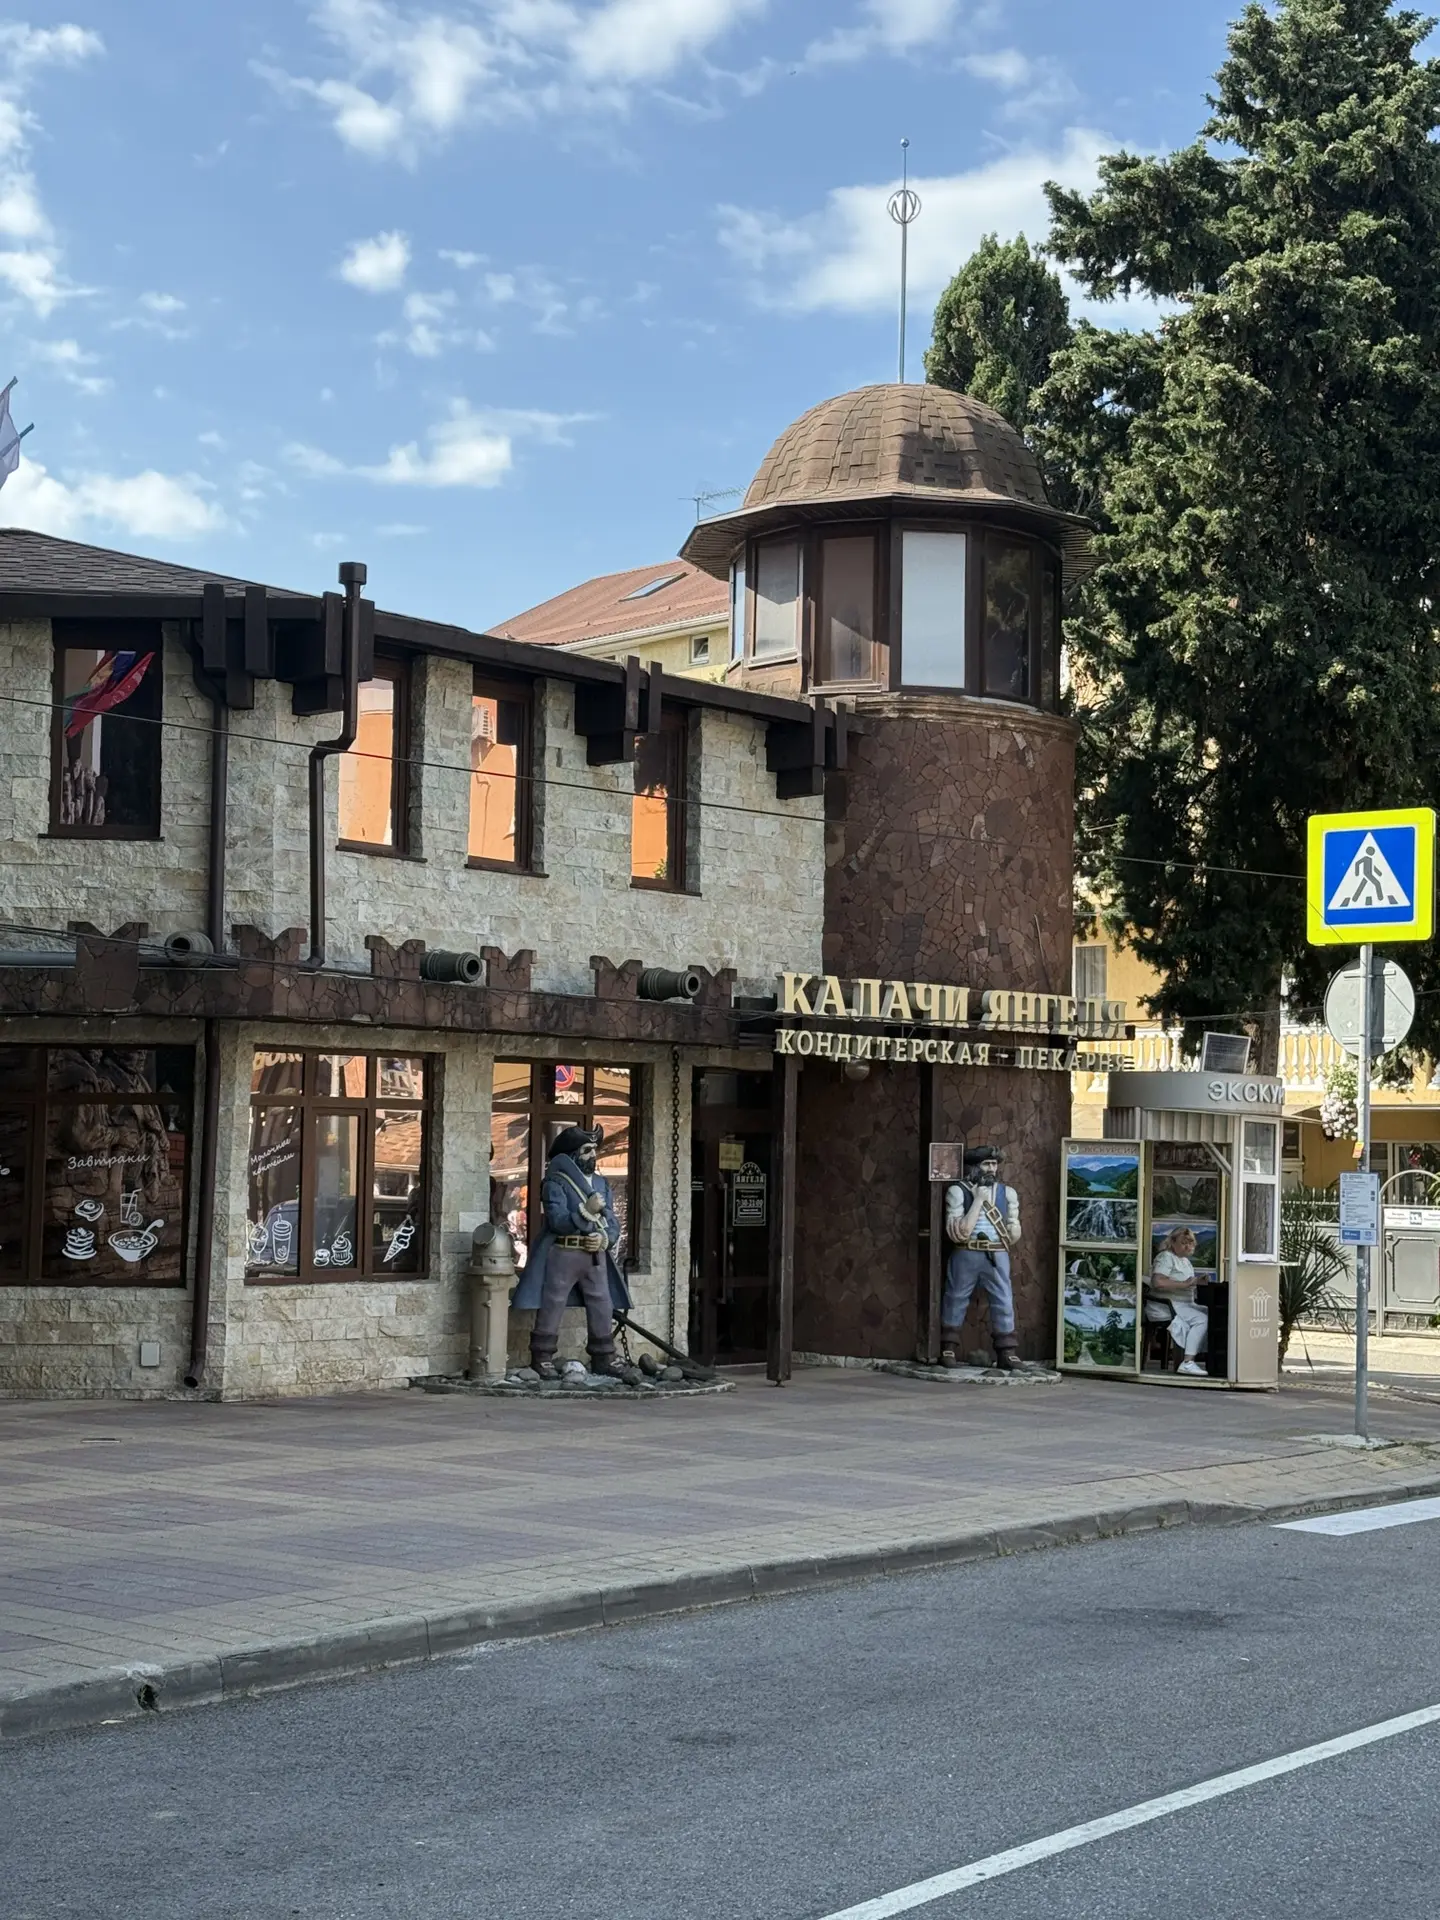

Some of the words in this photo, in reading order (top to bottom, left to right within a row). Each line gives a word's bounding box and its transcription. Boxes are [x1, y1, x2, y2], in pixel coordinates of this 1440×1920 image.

[776, 971, 970, 1028] КАЛАЧИ
[980, 989, 1128, 1039] ЯНГЕЛЯ
[775, 1028, 990, 1067] КОНДИТЕРСКАЯ
[1015, 1046, 1126, 1072] ПЕКАРНЯ
[67, 1154, 151, 1170] Завтраки
